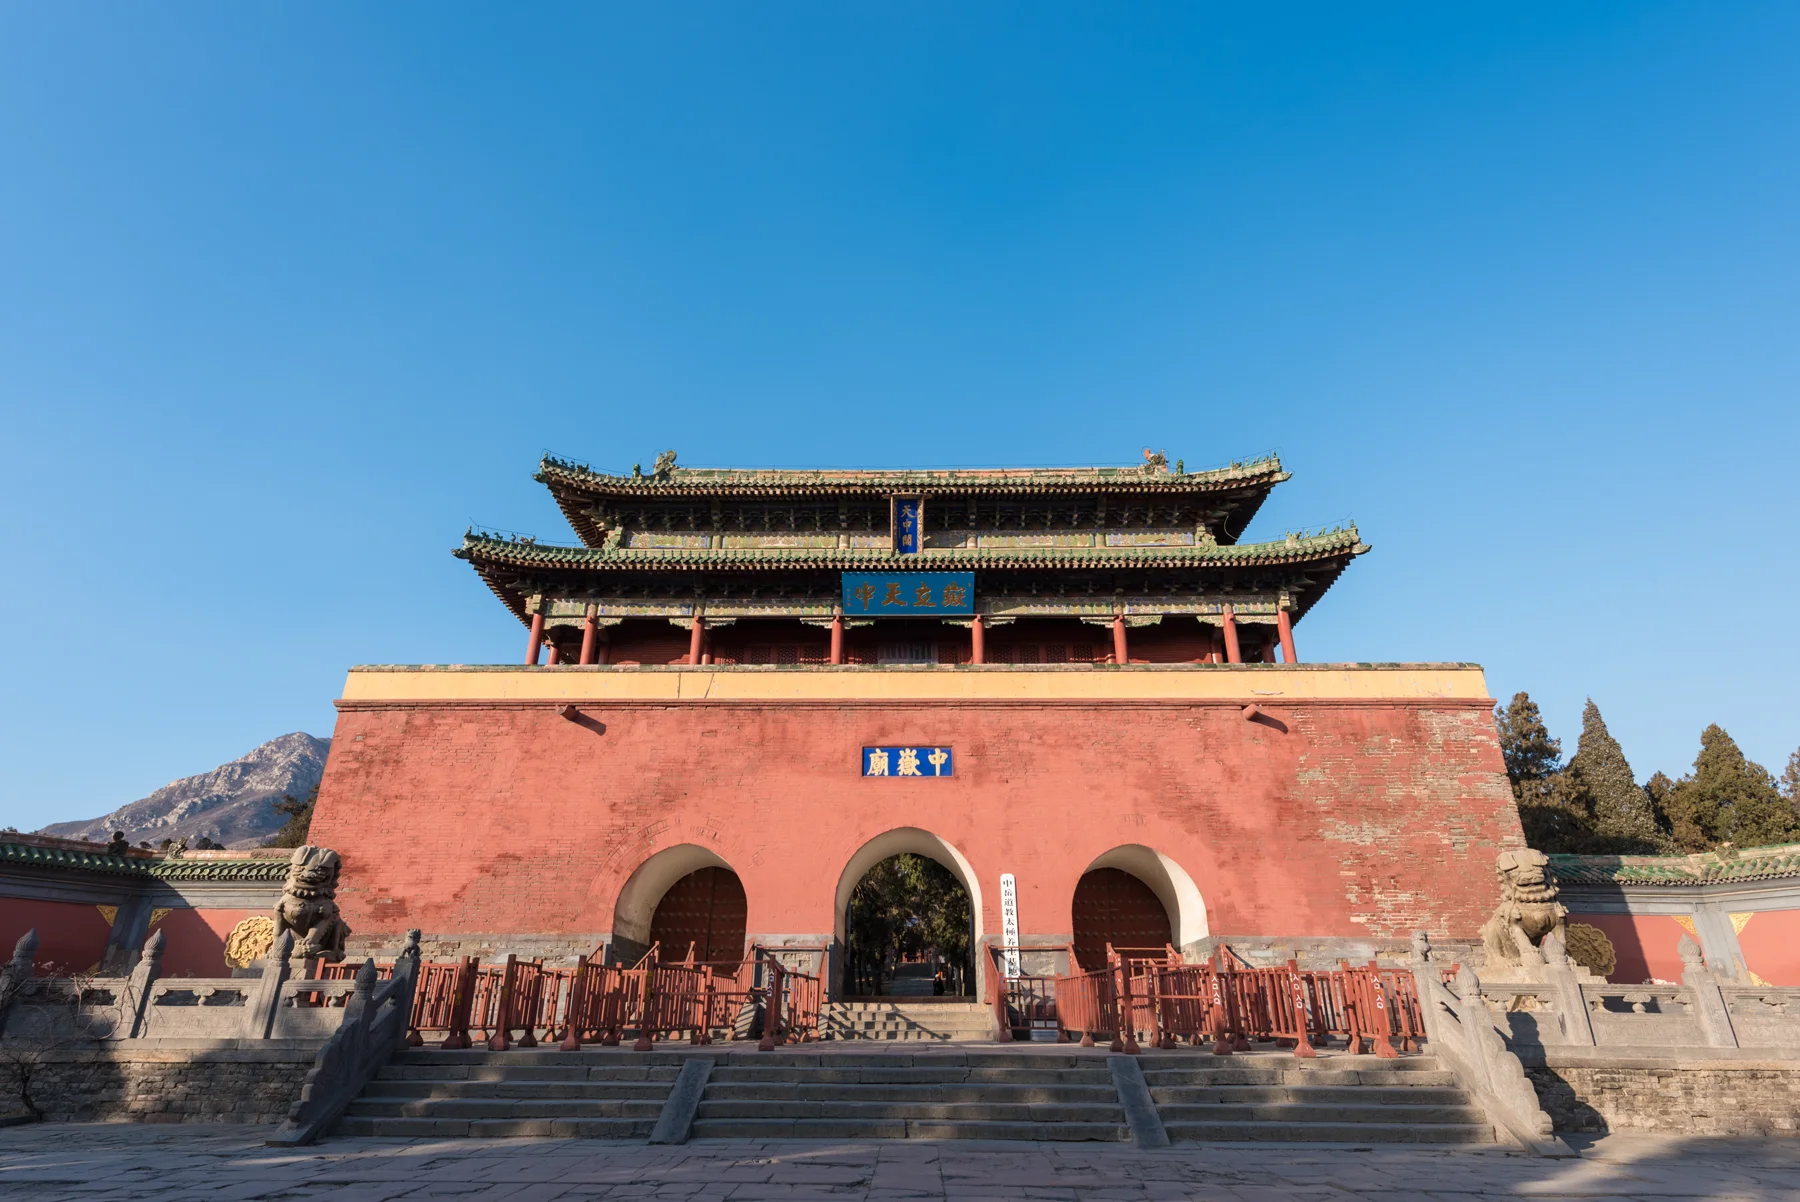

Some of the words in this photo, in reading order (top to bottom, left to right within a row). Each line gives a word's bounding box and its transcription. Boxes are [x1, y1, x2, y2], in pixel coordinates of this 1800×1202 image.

[900, 504, 917, 547] 天中閣
[866, 747, 949, 777] 中嶽廟
